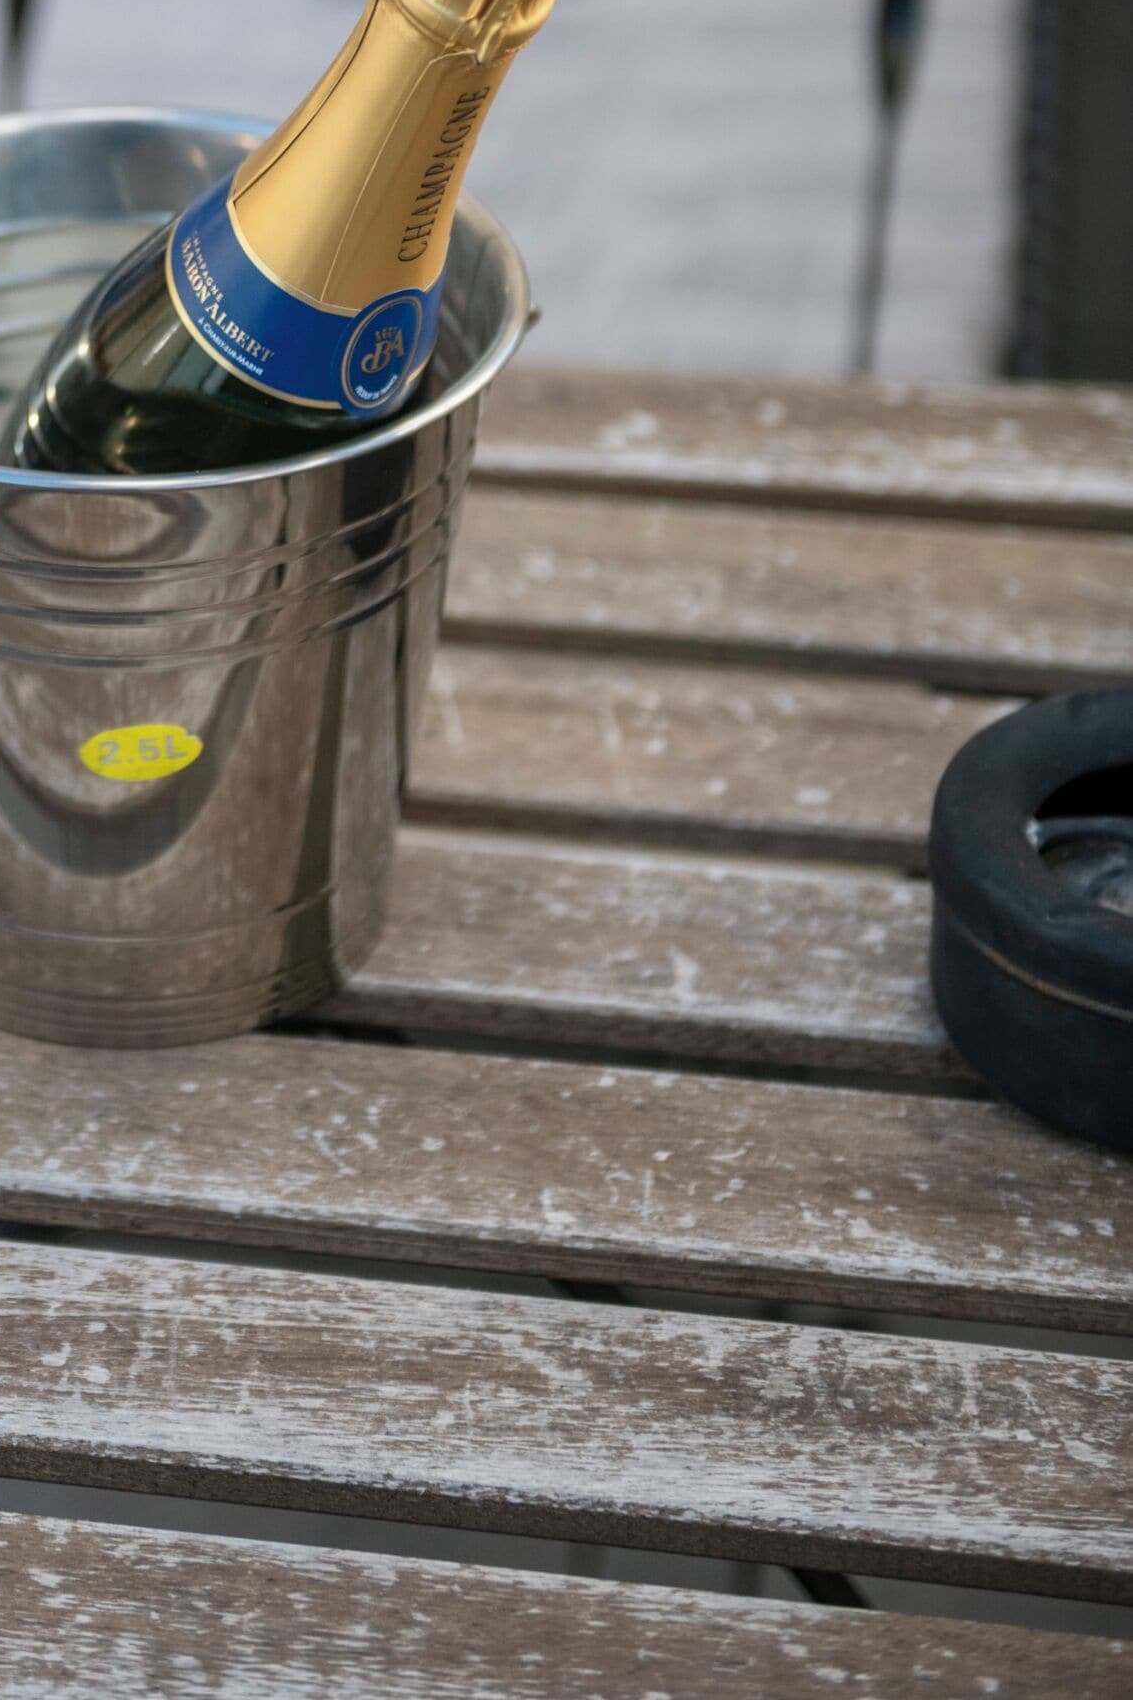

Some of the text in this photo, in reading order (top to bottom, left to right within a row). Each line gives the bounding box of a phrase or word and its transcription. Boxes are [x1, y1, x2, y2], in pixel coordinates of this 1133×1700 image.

[397, 85, 491, 263] CHAMPAGNE
[182, 237, 274, 362] BARON ALBERT
[193, 230, 224, 301] HAMPAGNE
[99, 734, 187, 764] 2.5L
